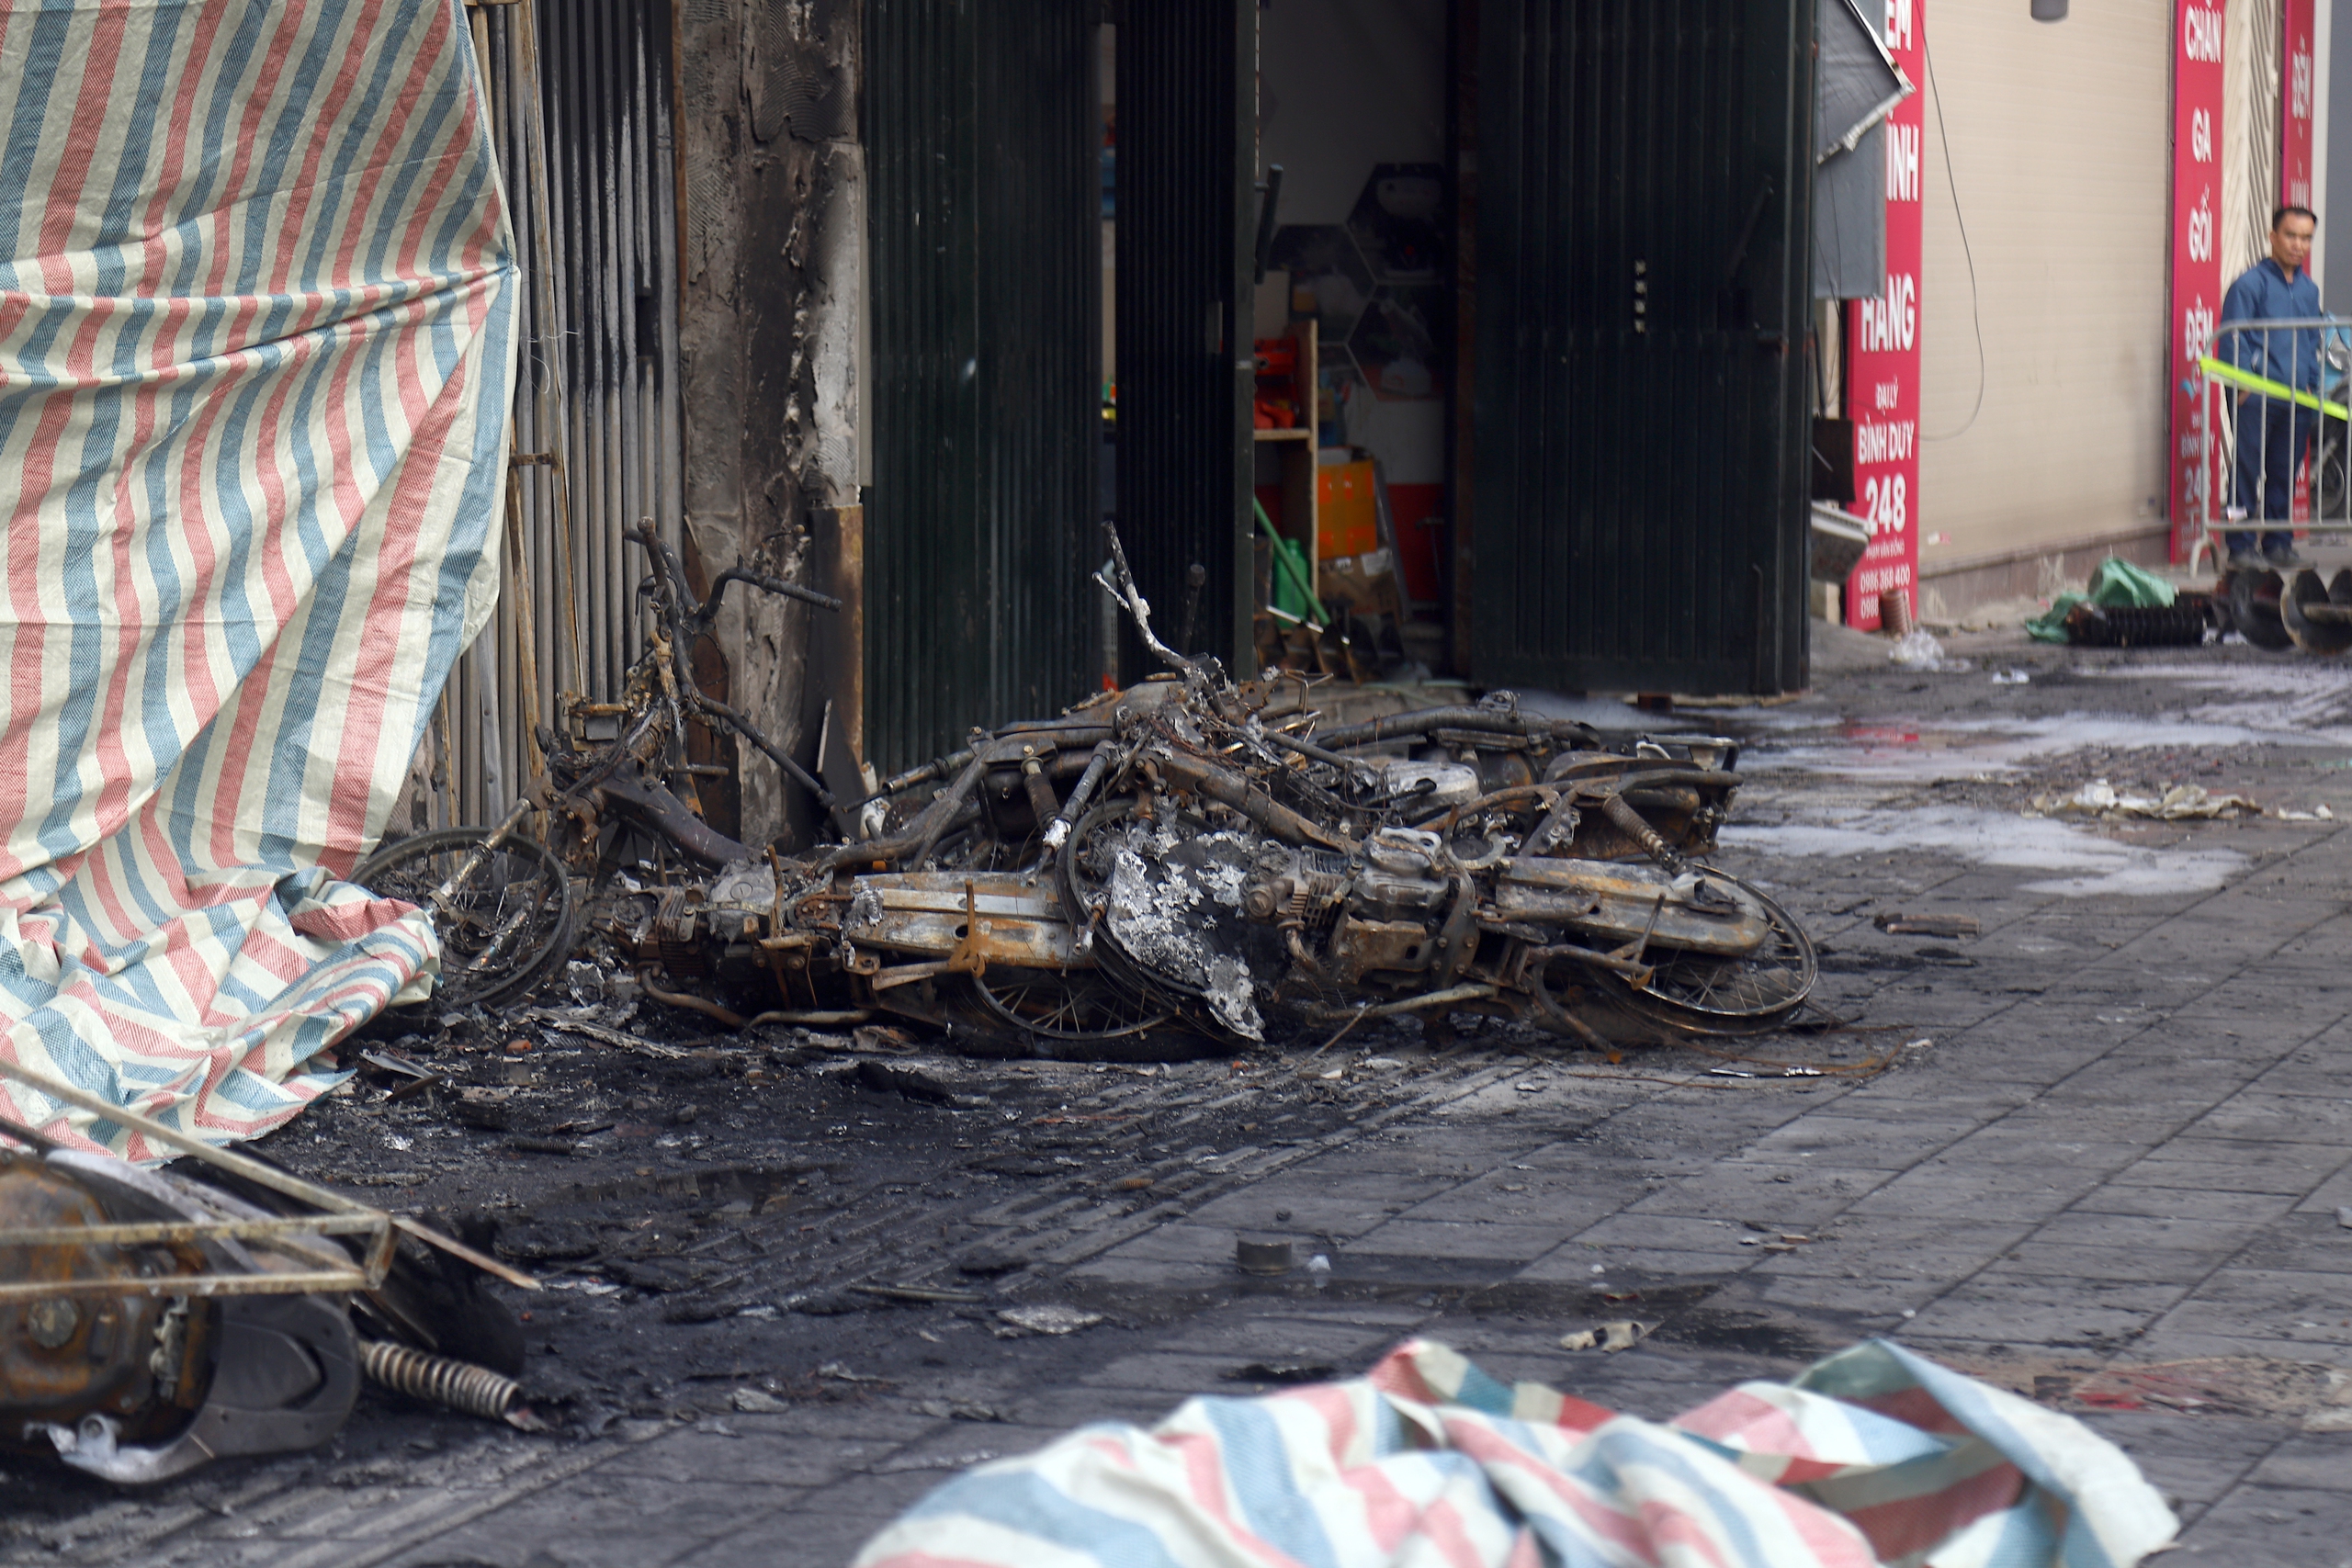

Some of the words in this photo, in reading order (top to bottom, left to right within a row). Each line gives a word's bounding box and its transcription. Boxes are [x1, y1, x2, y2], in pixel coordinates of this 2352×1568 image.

[2192, 107, 2212, 164] GA
[1858, 412, 1887, 465] BÌNH
[1888, 420, 1915, 461] DUY
[1865, 473, 1906, 536] 248
[1860, 569, 1879, 594] 0986
[1894, 562, 1911, 587] 400
[1860, 594, 1879, 620] 0988
